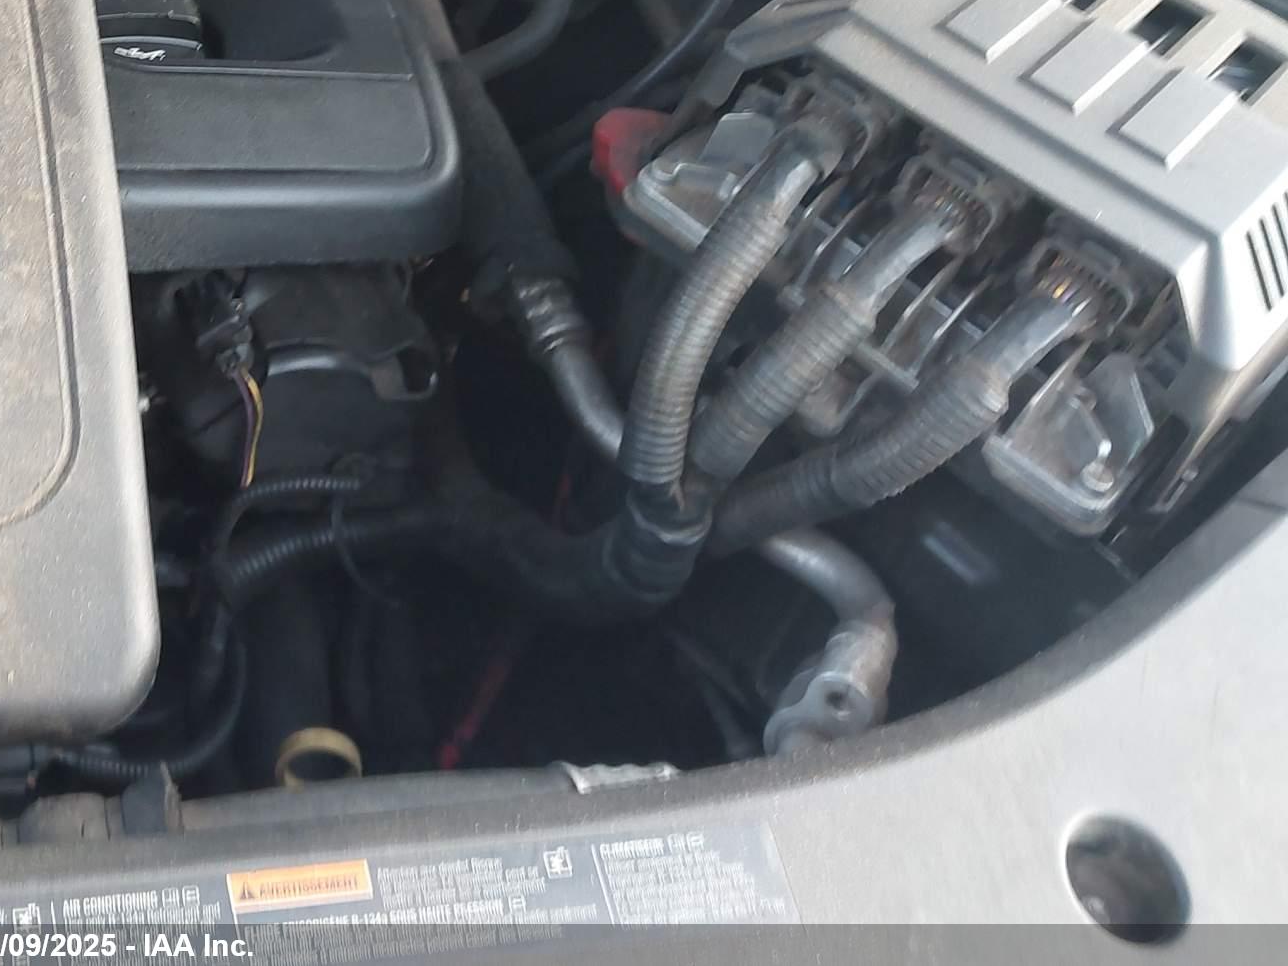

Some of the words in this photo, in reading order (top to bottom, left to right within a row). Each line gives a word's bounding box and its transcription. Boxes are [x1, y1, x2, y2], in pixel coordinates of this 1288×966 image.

[259, 874, 359, 898] AVERTISSEMENT
[63, 898, 81, 919] AIR
[83, 890, 158, 916] CONDITIONING
